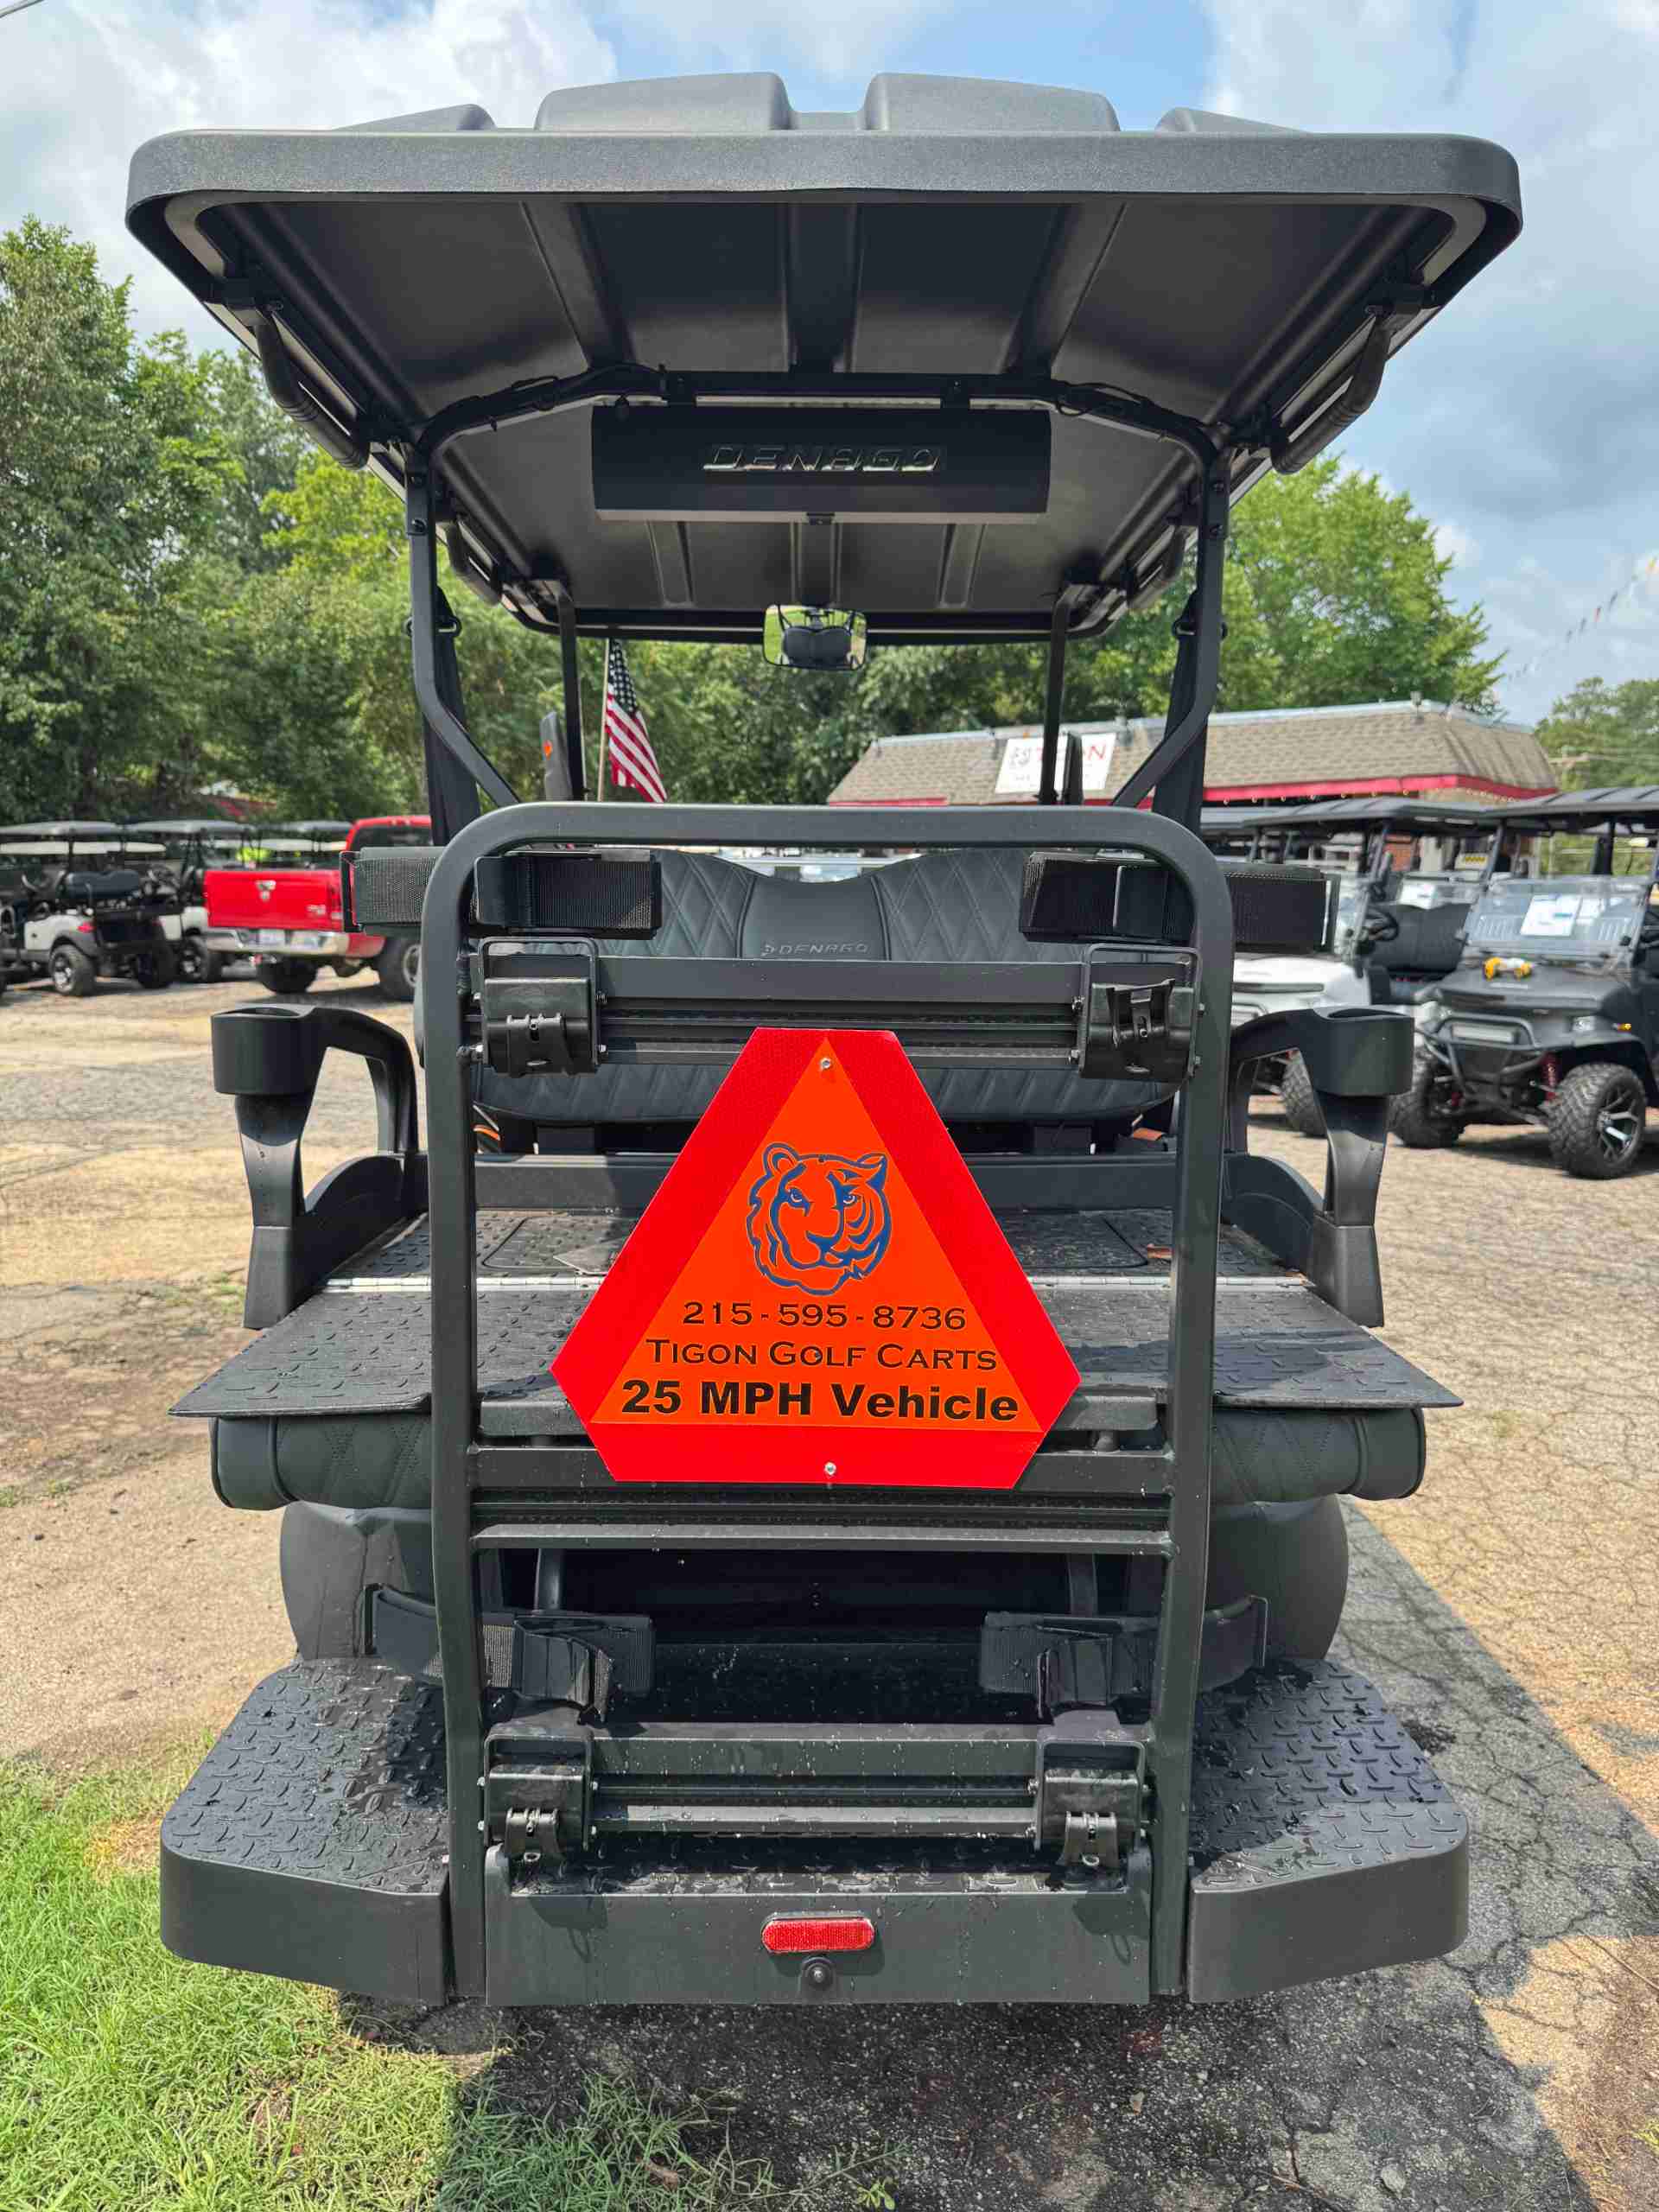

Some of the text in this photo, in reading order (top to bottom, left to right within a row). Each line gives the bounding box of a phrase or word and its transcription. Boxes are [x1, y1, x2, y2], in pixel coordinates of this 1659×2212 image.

[702, 446, 942, 472] DENAGO
[779, 943, 870, 956] DENAGO
[645, 1339, 996, 1370] TIGON GOLF CARTS
[621, 1379, 1018, 1421] 25 MPH Vehicle
